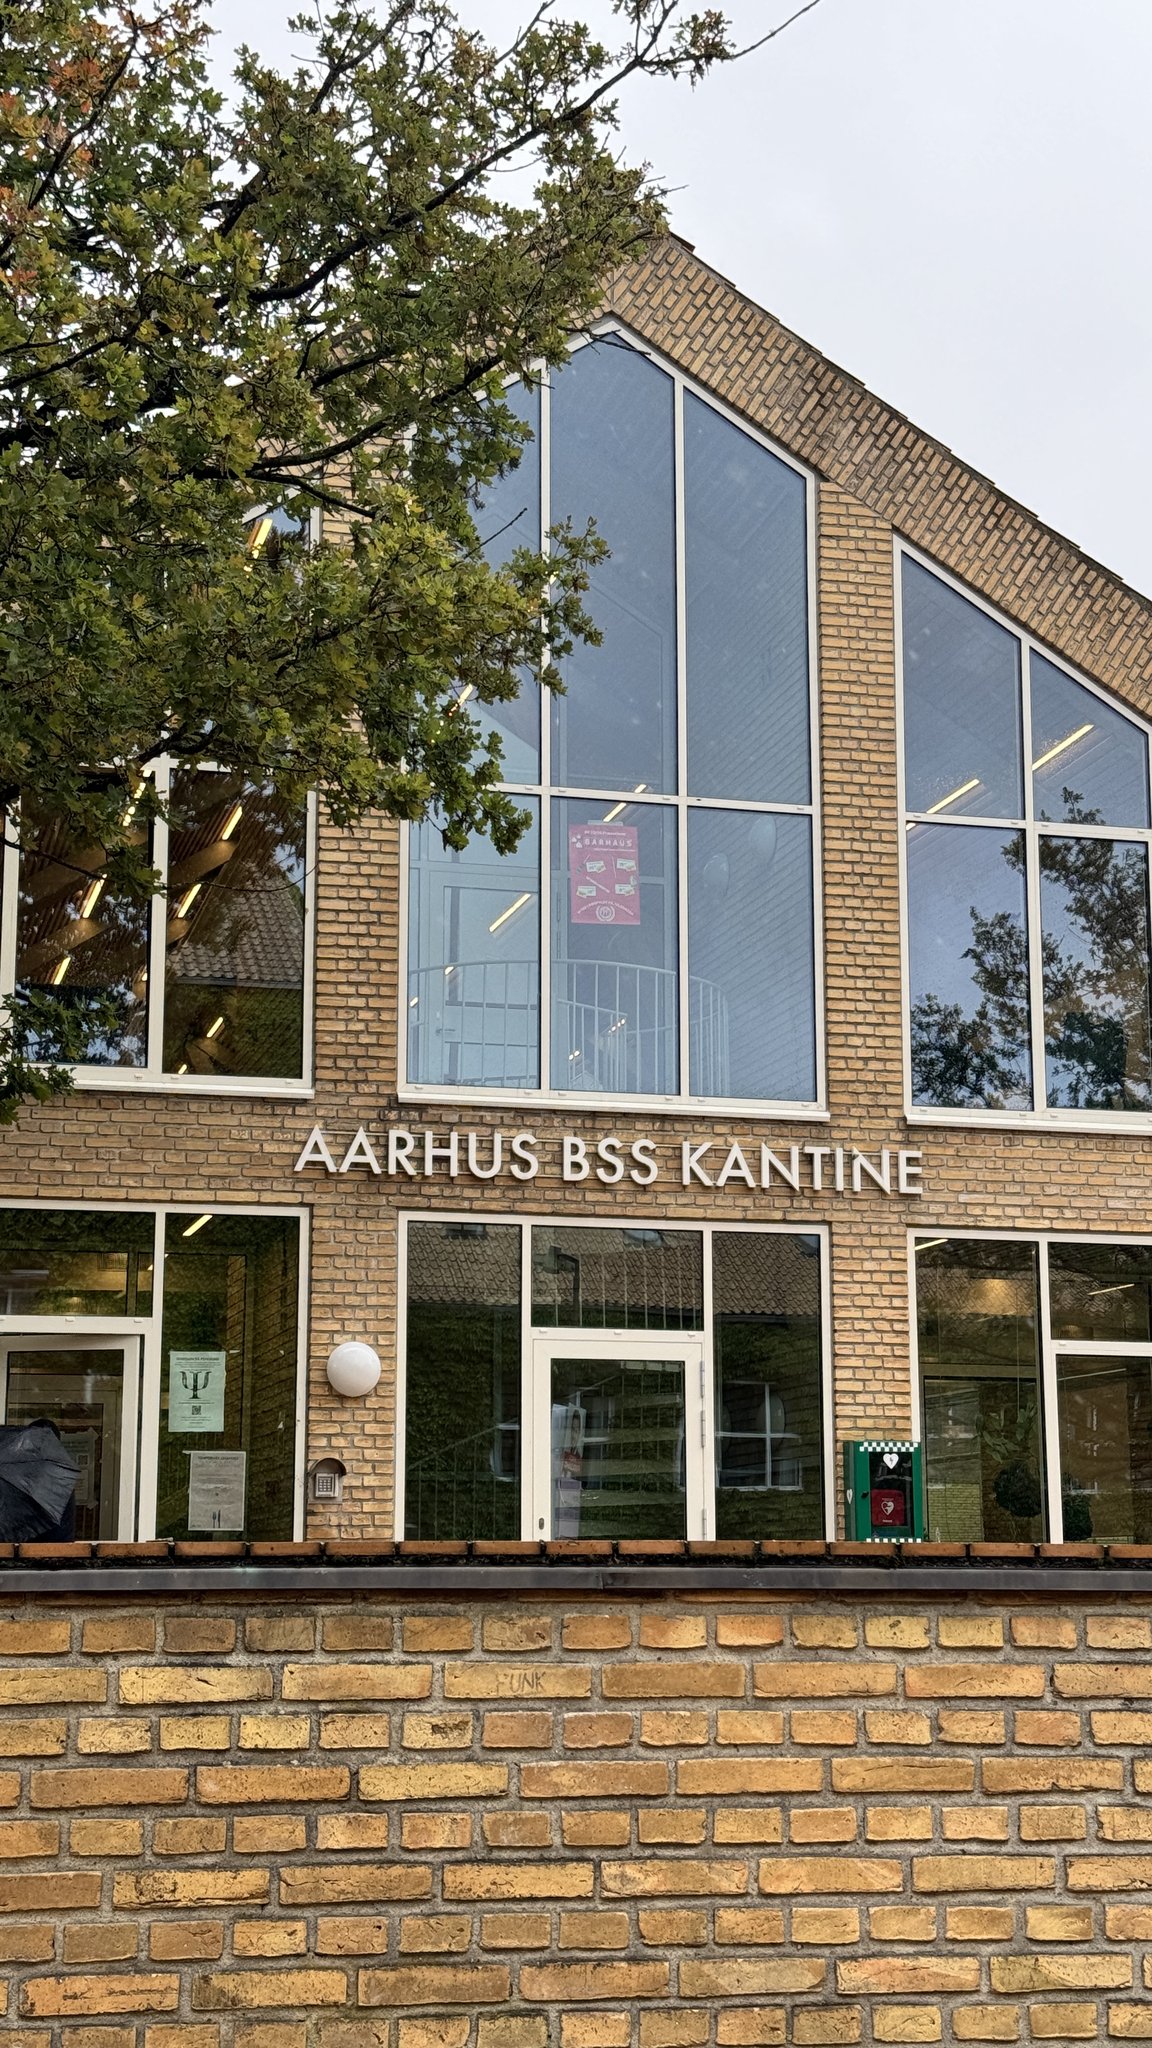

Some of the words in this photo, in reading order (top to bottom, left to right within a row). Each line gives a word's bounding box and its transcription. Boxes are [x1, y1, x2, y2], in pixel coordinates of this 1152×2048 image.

[293, 1126, 539, 1180] AARHUS
[562, 1136, 659, 1185] BSS
[682, 1140, 923, 1195] KANTINE
